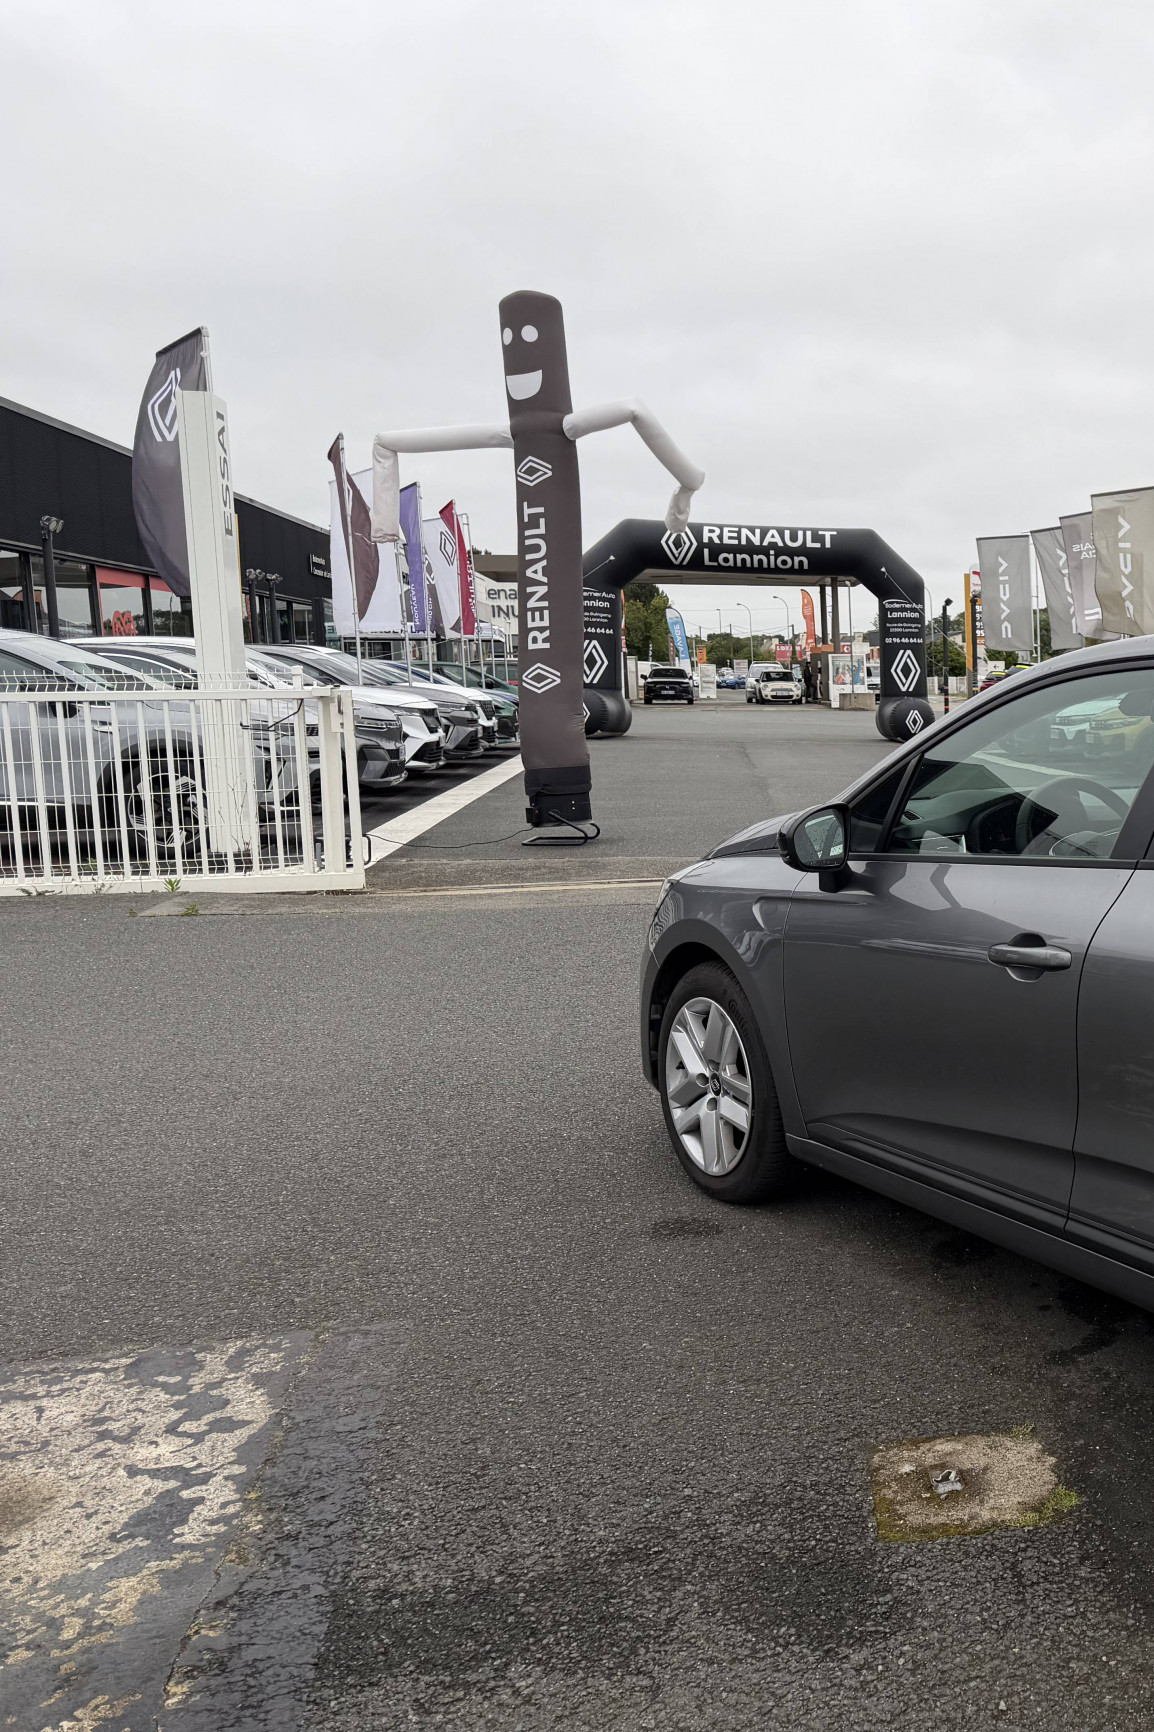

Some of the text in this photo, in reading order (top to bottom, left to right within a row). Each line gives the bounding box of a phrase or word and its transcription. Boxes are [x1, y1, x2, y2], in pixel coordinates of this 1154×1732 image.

[216, 411, 233, 536] ESSAI
[702, 526, 837, 549] RENAULT
[703, 548, 809, 570] Lannion
[523, 500, 551, 650] RENAULT
